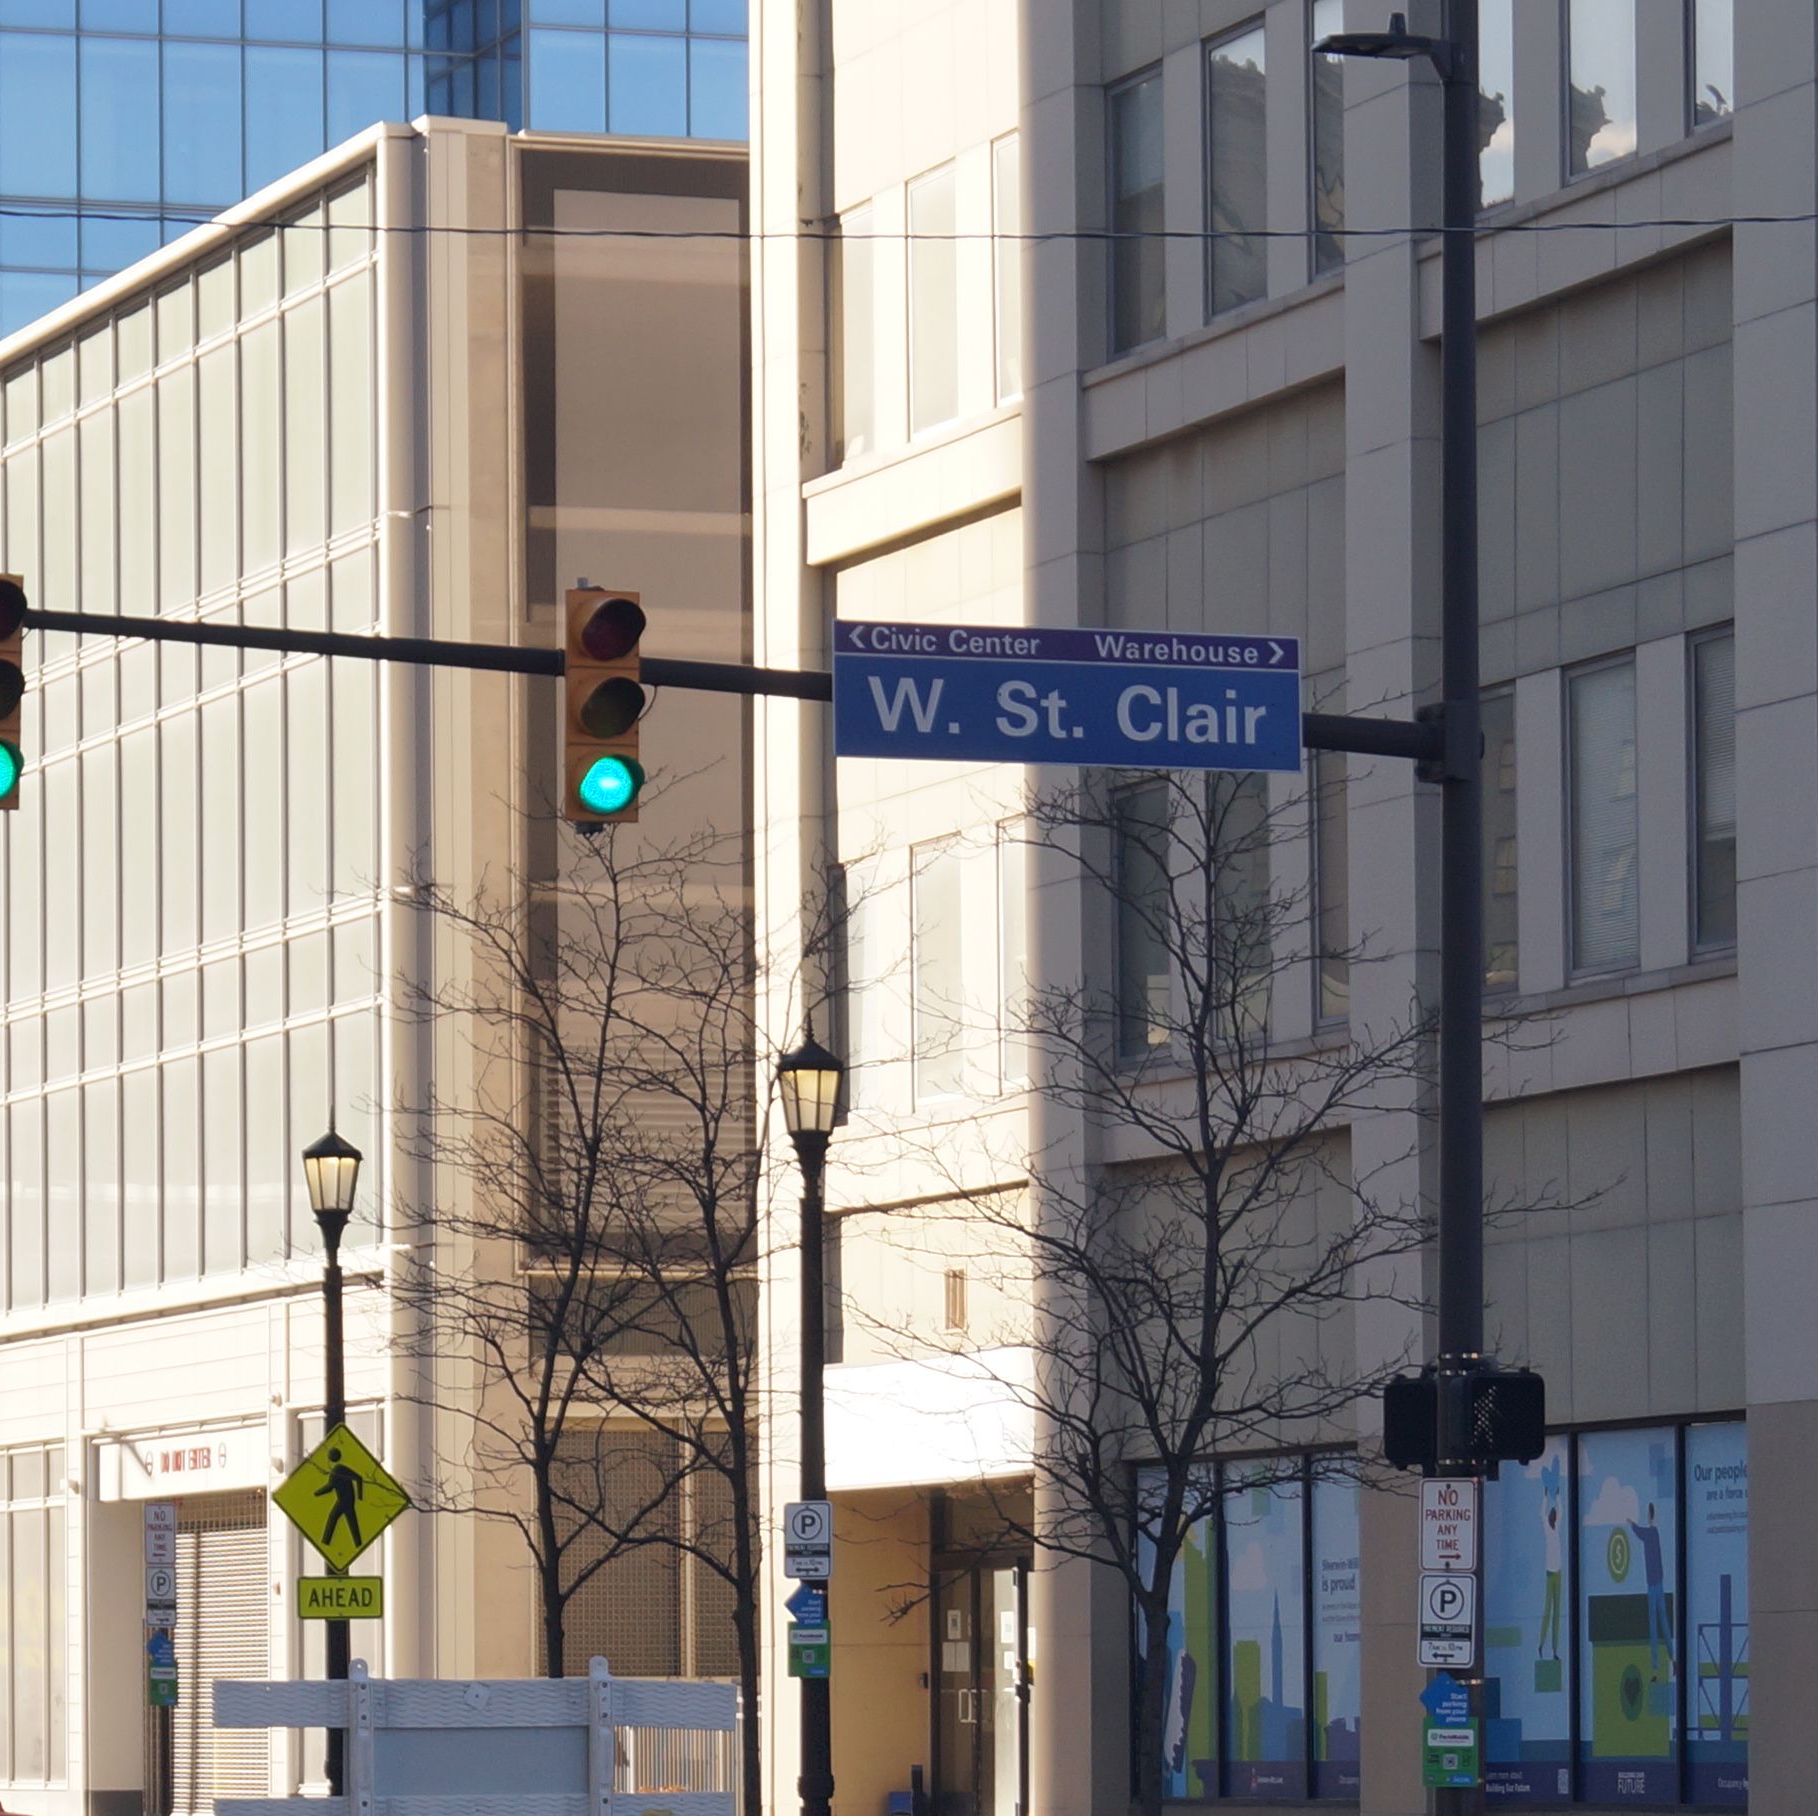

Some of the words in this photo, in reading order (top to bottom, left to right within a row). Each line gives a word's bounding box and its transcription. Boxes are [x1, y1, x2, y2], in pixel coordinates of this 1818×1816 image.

[871, 625, 938, 653] Civic
[948, 629, 1041, 656] Center
[1094, 634, 1260, 665] Warehouse
[867, 675, 961, 734] W.
[995, 680, 1084, 739] St.
[1116, 684, 1267, 745] Clair
[1694, 1464, 1712, 1481] Our
[1438, 1490, 1459, 1506] NO
[1425, 1509, 1471, 1521] PARKING
[801, 1515, 816, 1534] P
[1437, 1524, 1458, 1536] ANY
[1436, 1539, 1460, 1551] TIME
[157, 1576, 166, 1591] P
[309, 1588, 373, 1607] AHEAD
[1440, 1590, 1457, 1613] P
[1617, 1779, 1645, 1794] FUTURE
